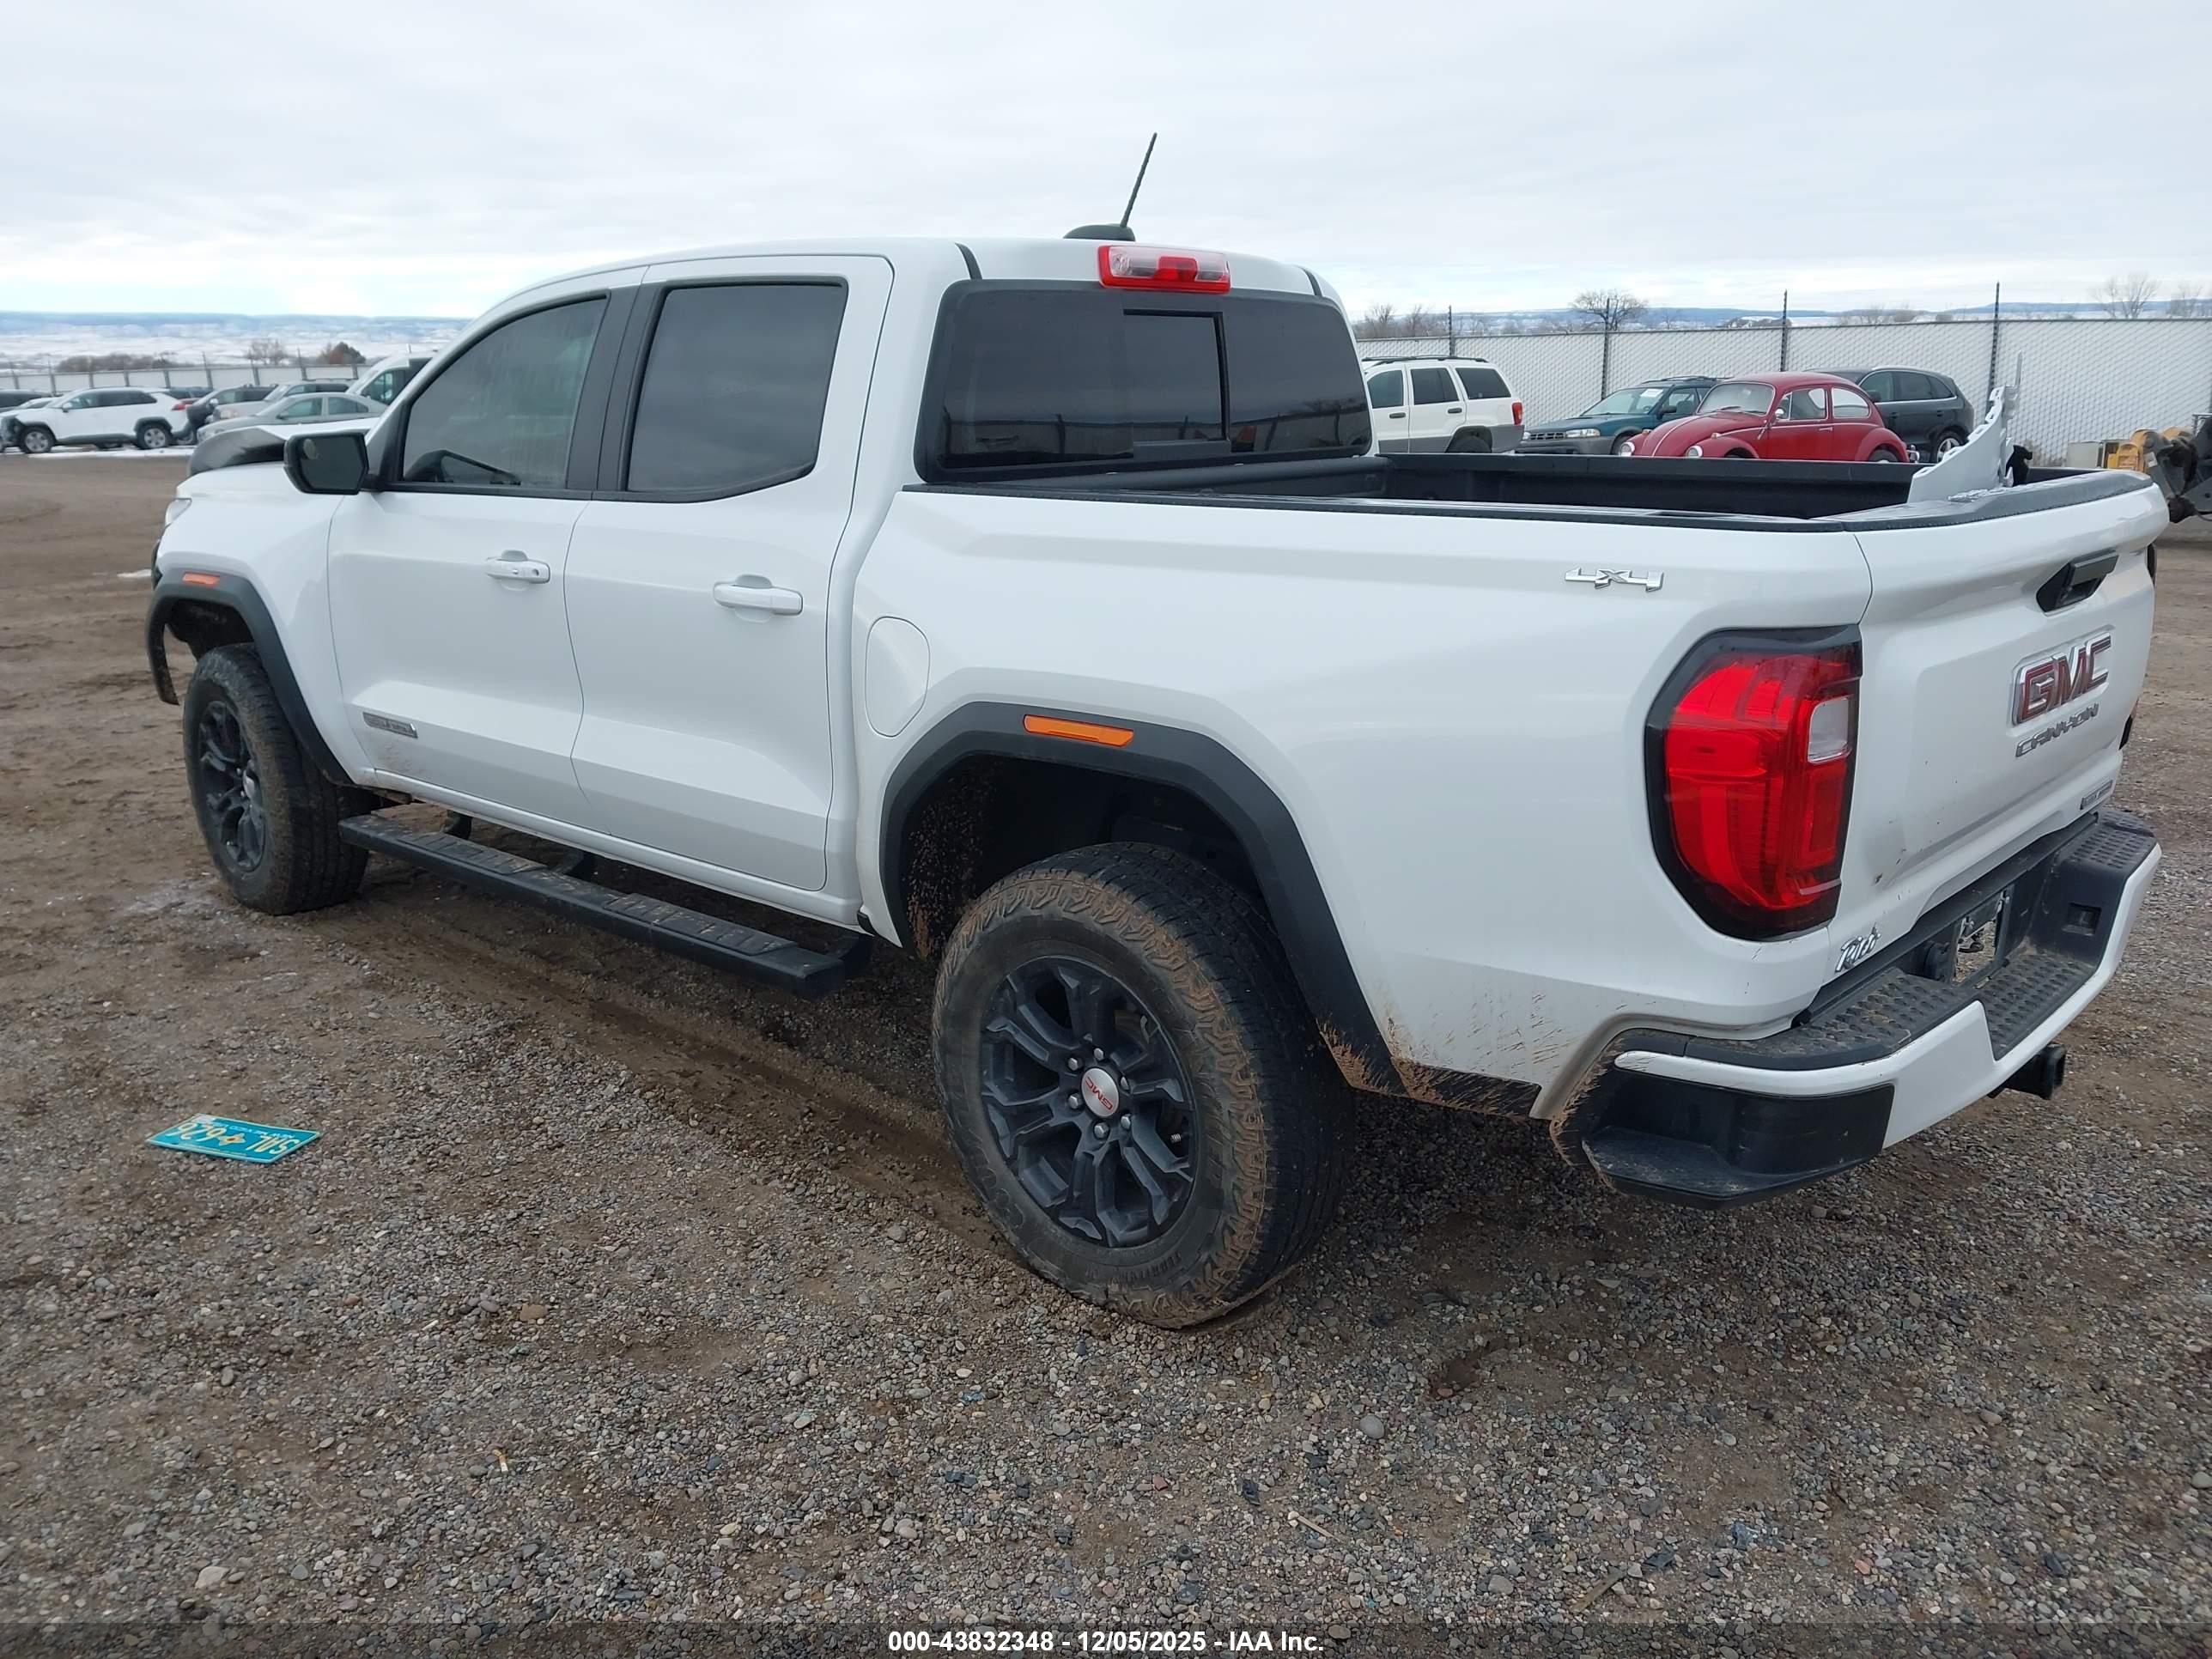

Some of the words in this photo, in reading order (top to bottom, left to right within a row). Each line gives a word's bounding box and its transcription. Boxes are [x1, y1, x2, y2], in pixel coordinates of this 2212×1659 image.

[2012, 632, 2112, 726] GMC
[2015, 703, 2100, 757] CANYON
[1085, 1075, 1114, 1110] GMC
